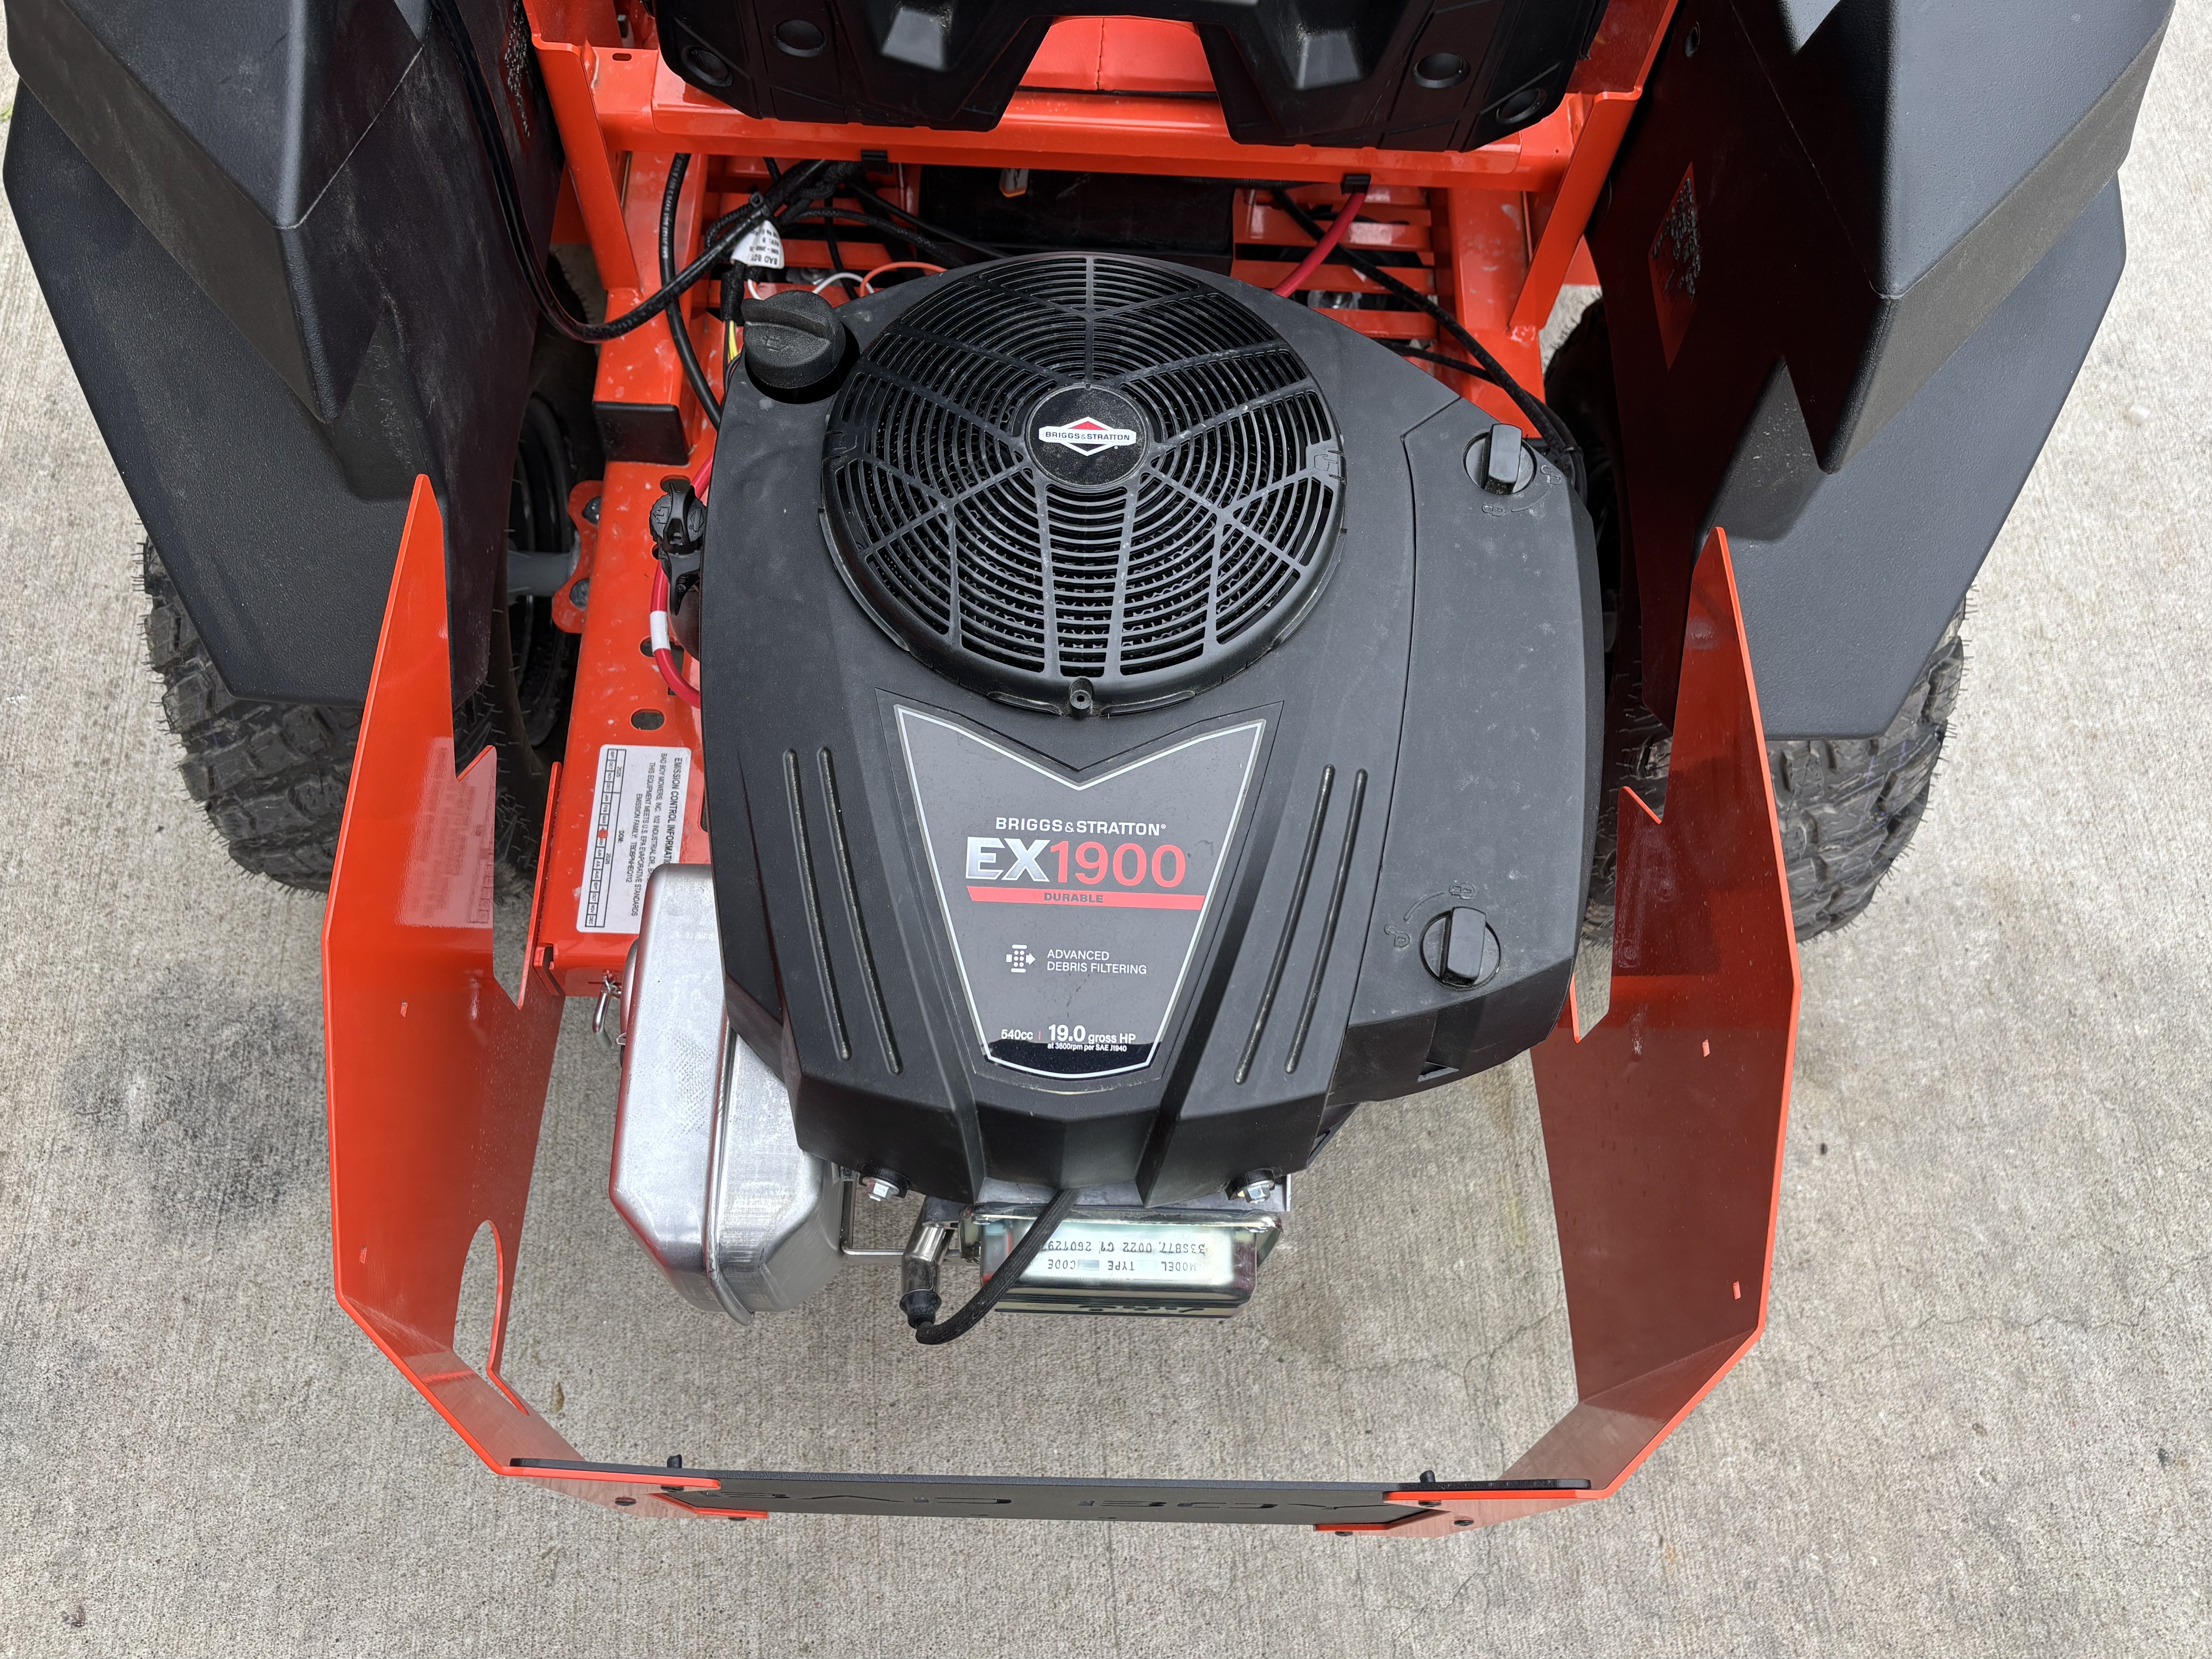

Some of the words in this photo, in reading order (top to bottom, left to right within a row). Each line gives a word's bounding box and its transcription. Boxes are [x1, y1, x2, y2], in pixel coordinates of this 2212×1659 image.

[764, 256, 778, 265] BAD
[672, 757, 682, 789] EMISSION
[645, 775, 654, 805] EQUIPMENT
[655, 776, 664, 800] MOWERS,
[632, 793, 642, 818] EMISSION
[668, 791, 678, 823] CONTROL
[650, 825, 659, 855] INDUSTRIAL
[635, 847, 647, 882] EVAPORATIVE
[965, 836, 1186, 888] EX1900
[632, 884, 642, 916] STANDARDS
[1044, 893, 1103, 903] DURABLE
[1047, 949, 1110, 960] ADVANCED
[1047, 961, 1088, 972] DEBRIS
[1091, 963, 1147, 974] FILTERING
[1001, 1029, 1034, 1040] 540cc
[1048, 1024, 1086, 1042] 19.0
[1088, 1034, 1117, 1044] gross
[1119, 1033, 1136, 1044] HP
[1122, 1242, 1152, 1253] 0022
[1048, 1259, 1076, 1269] CODE
[1108, 1261, 1134, 1271] TYPE
[1161, 1261, 1196, 1271] MODEL
